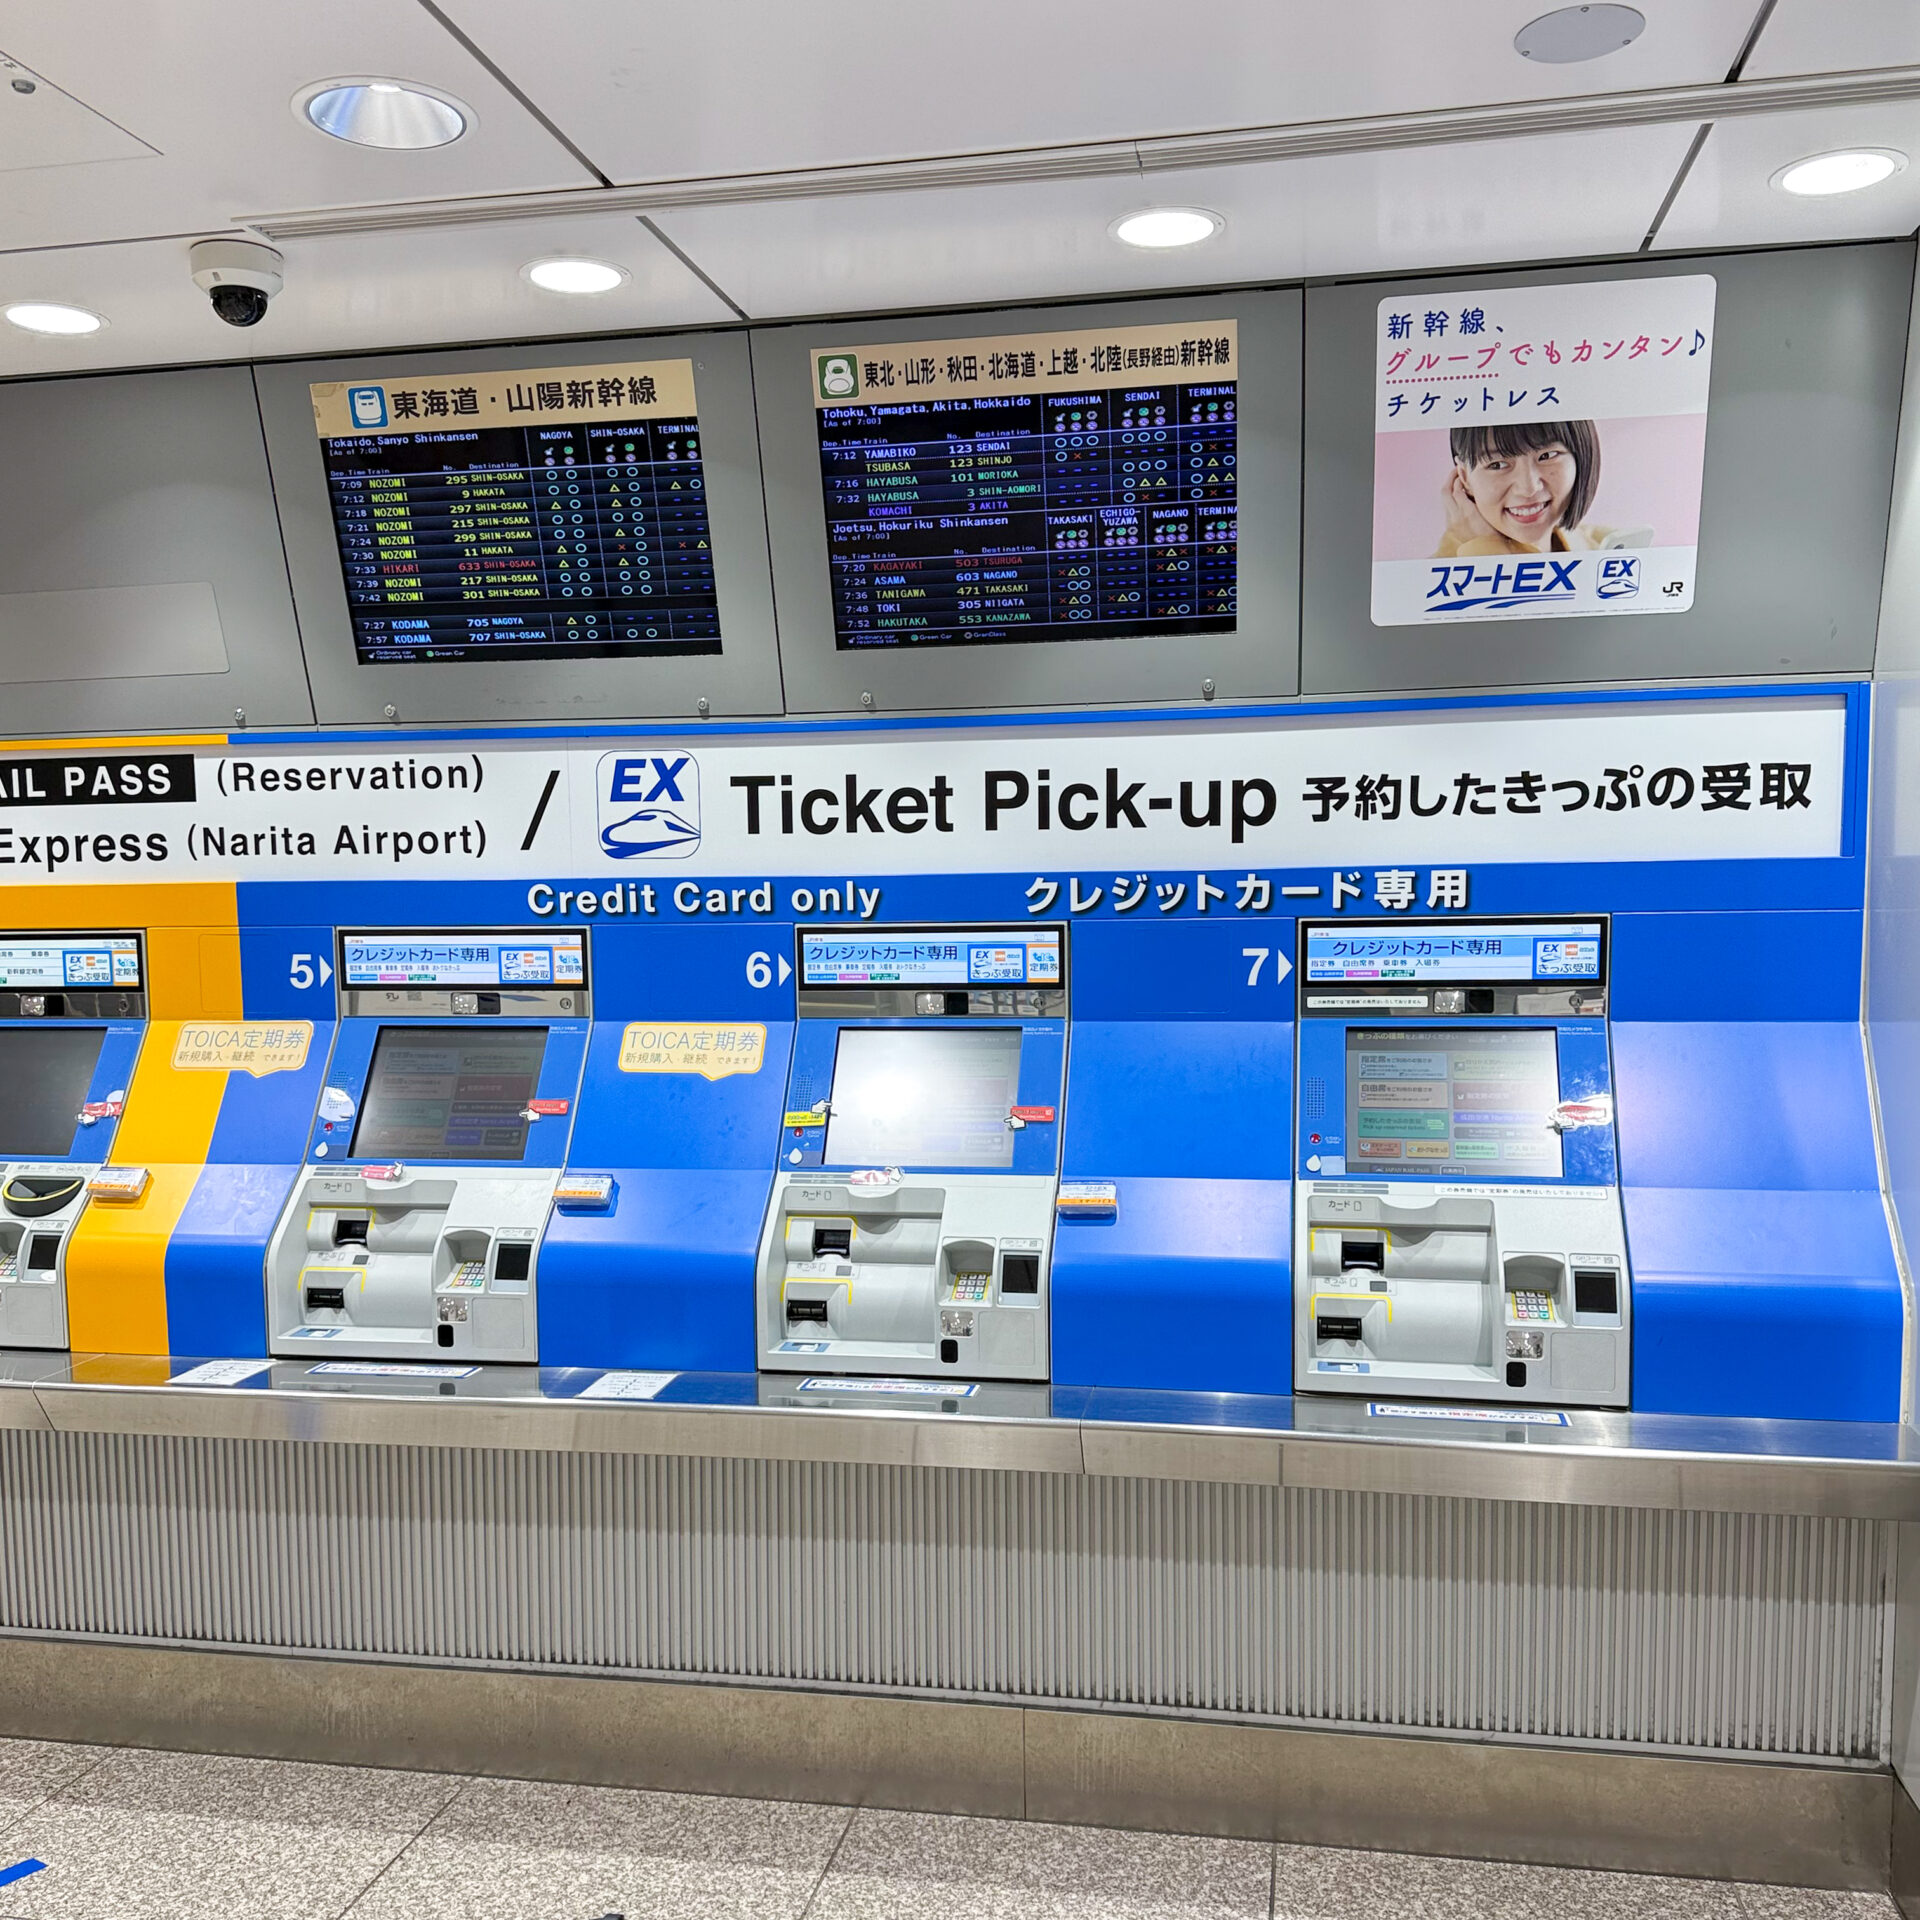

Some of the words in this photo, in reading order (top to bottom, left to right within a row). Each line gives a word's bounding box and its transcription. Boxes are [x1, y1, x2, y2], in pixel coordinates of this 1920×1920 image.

[391, 375, 658, 419] 東海道・山陽新幹線
[1048, 396, 1102, 407] FUKUSHIMA
[1125, 391, 1161, 401] SENDAI
[1188, 386, 1236, 397] TERMINAL
[1387, 386, 1560, 417] チケットレス
[414, 432, 479, 444] Shinkansen
[540, 431, 573, 440] NAGOYA
[590, 427, 645, 437] SHIN-OSAKA
[832, 452, 857, 460] 7:12
[864, 448, 916, 458] YAMABIKO
[948, 445, 972, 454] 123
[976, 443, 1011, 452] SENDAI
[866, 462, 911, 473] TSUBASA
[949, 458, 973, 468] 123
[977, 456, 1012, 465] SHINJO
[341, 481, 362, 489] 7:09
[369, 478, 406, 488] NOZOMI
[446, 476, 468, 485] 295
[471, 472, 526, 482] SHIN-OSAKA
[835, 479, 859, 488] 7:16
[867, 476, 918, 487] HAYABUSA
[951, 473, 973, 482] 101
[978, 470, 1018, 480] MORIOKA
[343, 495, 365, 503] 7:12
[371, 492, 408, 503] NOZOMI
[462, 490, 470, 498] 9
[473, 488, 505, 497] HAKATA
[837, 495, 860, 503] 7:32
[868, 492, 919, 503] HAYABUSA
[967, 488, 975, 497] 3
[979, 485, 1041, 495] SHIN-AOMORI
[344, 507, 367, 517] 7:18
[373, 506, 411, 518] NOZOMI
[449, 503, 472, 514] 297
[473, 500, 528, 513] SHIN-OSAKA
[868, 506, 913, 517] KOMACHI
[968, 502, 976, 511] 3
[980, 501, 1008, 510] AKITA
[1048, 515, 1093, 525] TAKASAKI
[1103, 516, 1138, 526] YUZAWA
[1152, 509, 1189, 519] NAGANO
[1100, 508, 1141, 518] ECHIGO-
[347, 522, 369, 532] 7:21
[375, 520, 413, 532] NOZOMI
[451, 517, 474, 528] 215
[475, 515, 530, 527] SHIN-OSAKA
[940, 516, 1008, 528] Shinkansen
[349, 538, 372, 546] 7:24
[378, 536, 415, 546] NOZOMI
[454, 533, 476, 543] 299
[479, 531, 532, 541] SHIN-OSAKA
[352, 552, 374, 560] 7:30
[380, 550, 418, 560] NOZOMI
[464, 548, 478, 556] 11
[481, 546, 514, 555] HAKATA
[354, 566, 376, 574] 7:33
[383, 564, 420, 574] HIKARI
[459, 562, 481, 571] 633
[484, 560, 536, 569] SHIN-OSAKA
[842, 564, 865, 573] 7:20
[873, 561, 923, 571] KAGAYAKI
[955, 558, 979, 567] 503
[984, 556, 1023, 565] TSURUGA
[1602, 559, 1637, 578] EX
[357, 580, 379, 588] 7:39
[385, 578, 422, 588] NOZOMI
[461, 576, 482, 585] 217
[486, 574, 538, 584] SHIN-OSAKA
[843, 578, 867, 586] 7:24
[874, 576, 906, 585] ASAMA
[956, 572, 979, 581] 603
[983, 571, 1018, 580] NAGANO
[1426, 559, 1583, 599] スマートEX
[359, 594, 381, 602] 7:42
[388, 592, 424, 602] NOZOMI
[463, 590, 485, 599] 301
[487, 588, 541, 598] SHIN-OSAKA
[845, 591, 868, 600] 7:36
[876, 588, 926, 599] TANIGAWA
[956, 586, 980, 595] 471
[984, 584, 1029, 593] TAKASAKI
[1663, 582, 1683, 593] JR
[846, 605, 869, 613] 7:48
[876, 603, 901, 613] TOKI
[957, 600, 981, 609] 305
[985, 598, 1025, 607] NIIGATA
[363, 622, 385, 630] 7:27
[391, 620, 430, 630] KODAMA
[467, 618, 489, 627] 705
[492, 617, 524, 626] NAGOYA
[847, 619, 870, 628] 7:52
[877, 617, 928, 627] HAKUTAKA
[959, 615, 982, 624] 553
[986, 613, 1031, 622] KANAZAWA
[366, 636, 388, 644] 7:57
[394, 634, 432, 644] KODAMA
[469, 633, 491, 642] 707
[494, 631, 547, 640] SHIN-OSAKA
[63, 762, 172, 798] PASS
[216, 752, 485, 798] (Reservation)
[608, 757, 690, 803] EX
[729, 768, 954, 836] Ticket
[984, 768, 1276, 844] Pick-up
[1301, 761, 1813, 822] 予約したきっぷの受取
[0, 827, 168, 872] Express
[186, 822, 317, 862] (Narita
[332, 819, 487, 864] Airport)
[526, 882, 658, 916] Credit
[672, 881, 774, 914] Card
[790, 880, 882, 918] only
[1023, 869, 1471, 915] クレジットカード専用
[351, 948, 489, 962] クレジットカード専用
[809, 946, 958, 961] クレジットカード専用
[1332, 940, 1502, 957] クレジットカード専用
[289, 953, 312, 989] 5
[555, 964, 582, 974] 定期券
[746, 952, 773, 990] 6
[1030, 962, 1058, 972] 定期券
[1241, 948, 1270, 986] 7
[184, 1029, 305, 1049] TOICA定期券
[629, 1031, 759, 1052] TOICA定期券
[801, 1190, 821, 1199] カード
[1328, 1200, 1350, 1209] カード
